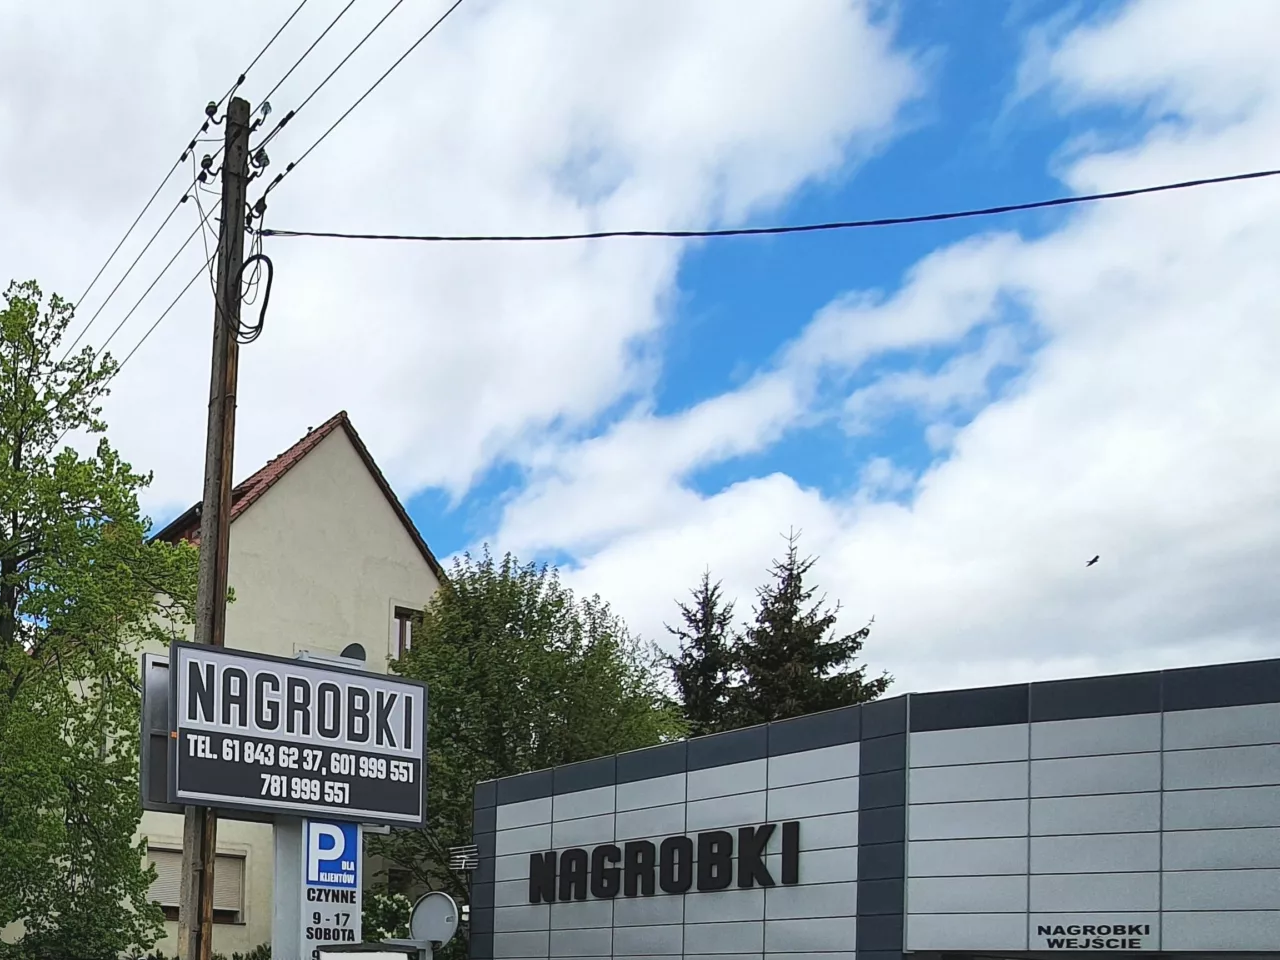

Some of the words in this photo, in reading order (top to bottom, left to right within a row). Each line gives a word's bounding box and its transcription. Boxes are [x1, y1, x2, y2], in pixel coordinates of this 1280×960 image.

[185, 658, 414, 751] NAGROBKI
[187, 733, 218, 759] TEL.
[222, 738, 240, 762] 61
[244, 741, 275, 766] 843
[278, 745, 299, 769] 62
[302, 748, 327, 776] 37,
[330, 752, 356, 776] 601
[359, 756, 387, 780] 999
[389, 760, 414, 783] 551
[260, 773, 287, 798] 781
[291, 777, 321, 801] 999
[324, 780, 350, 804] 551
[308, 822, 345, 881] P
[341, 860, 355, 871] DLA
[528, 821, 800, 903] NAGROBKI
[319, 872, 355, 884] KLIENTÓW
[306, 887, 357, 904] CZYNNE
[312, 911, 321, 925] 9
[334, 912, 351, 927] 17
[306, 926, 356, 942] SOBOTA
[1037, 924, 1150, 936] NAGROBKI
[1046, 936, 1142, 949] WEJŚCIE
